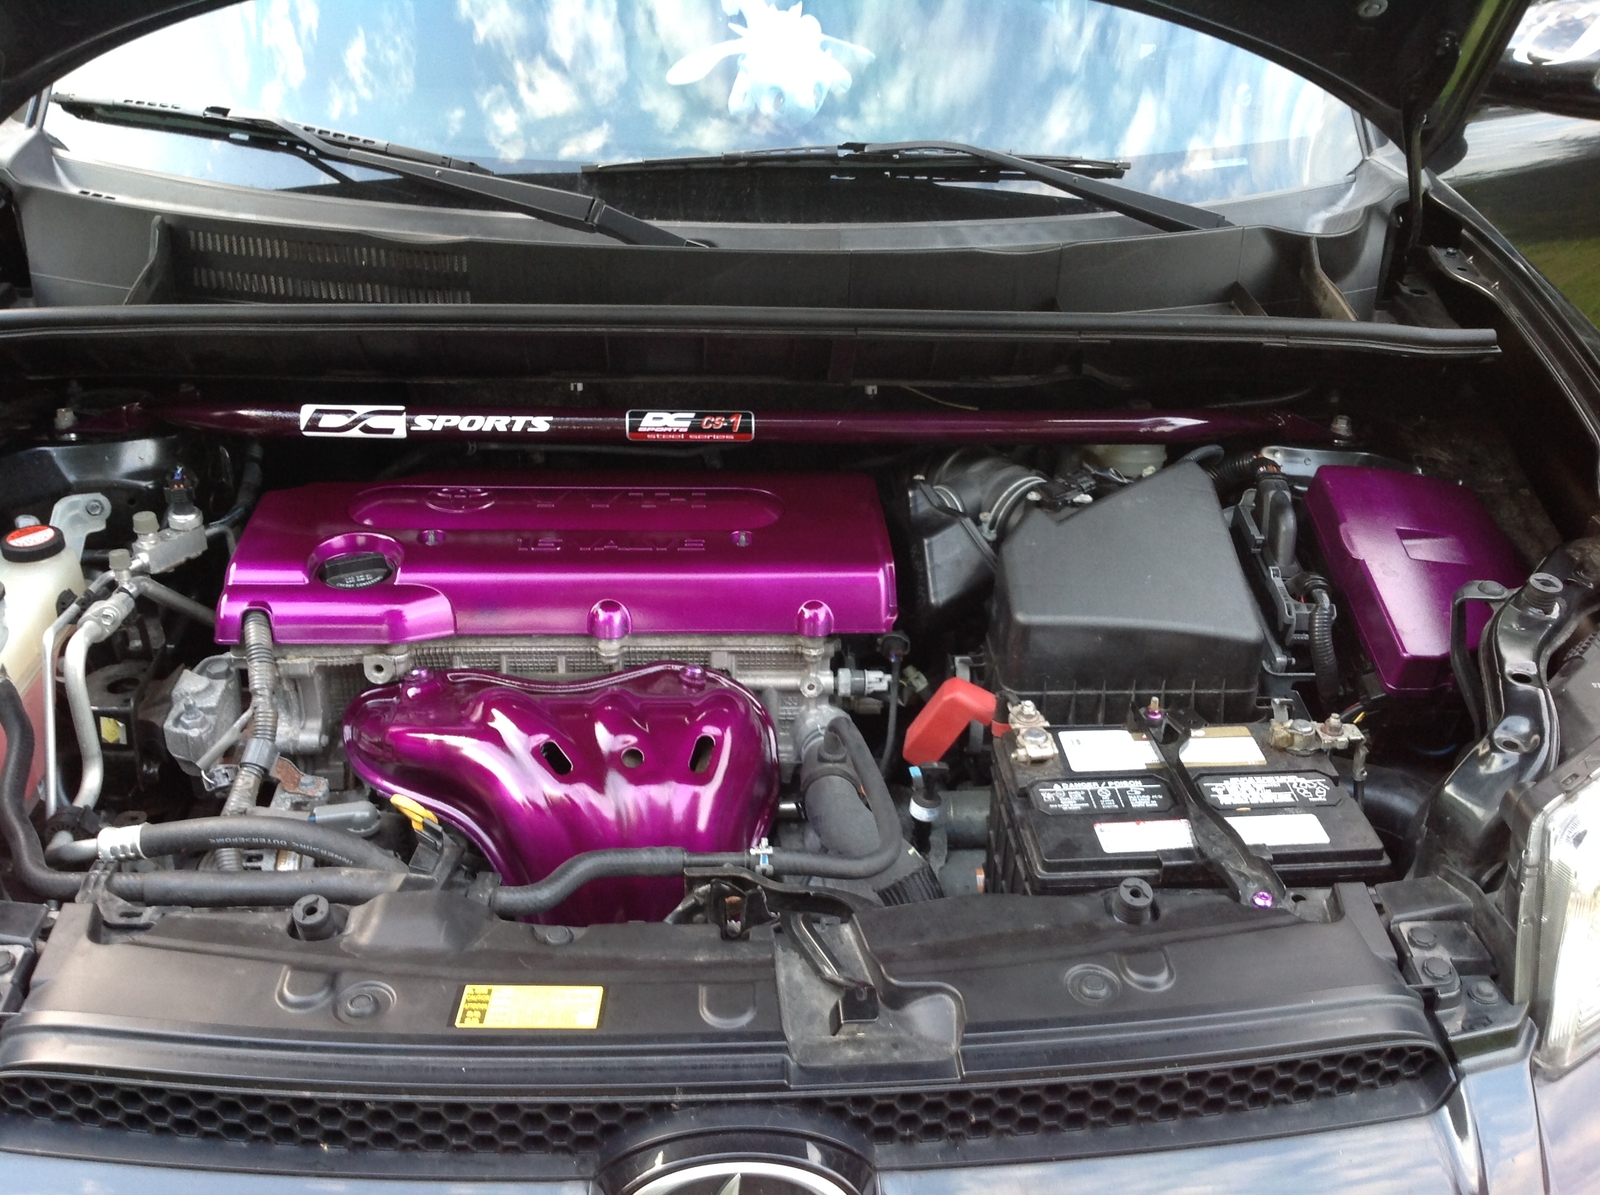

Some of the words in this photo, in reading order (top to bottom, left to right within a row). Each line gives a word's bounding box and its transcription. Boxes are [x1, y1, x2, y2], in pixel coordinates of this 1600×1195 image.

[410, 415, 553, 432] SPORTS
[640, 412, 696, 427] DC
[701, 413, 742, 433] CS-1
[1108, 780, 1143, 788] POISON
